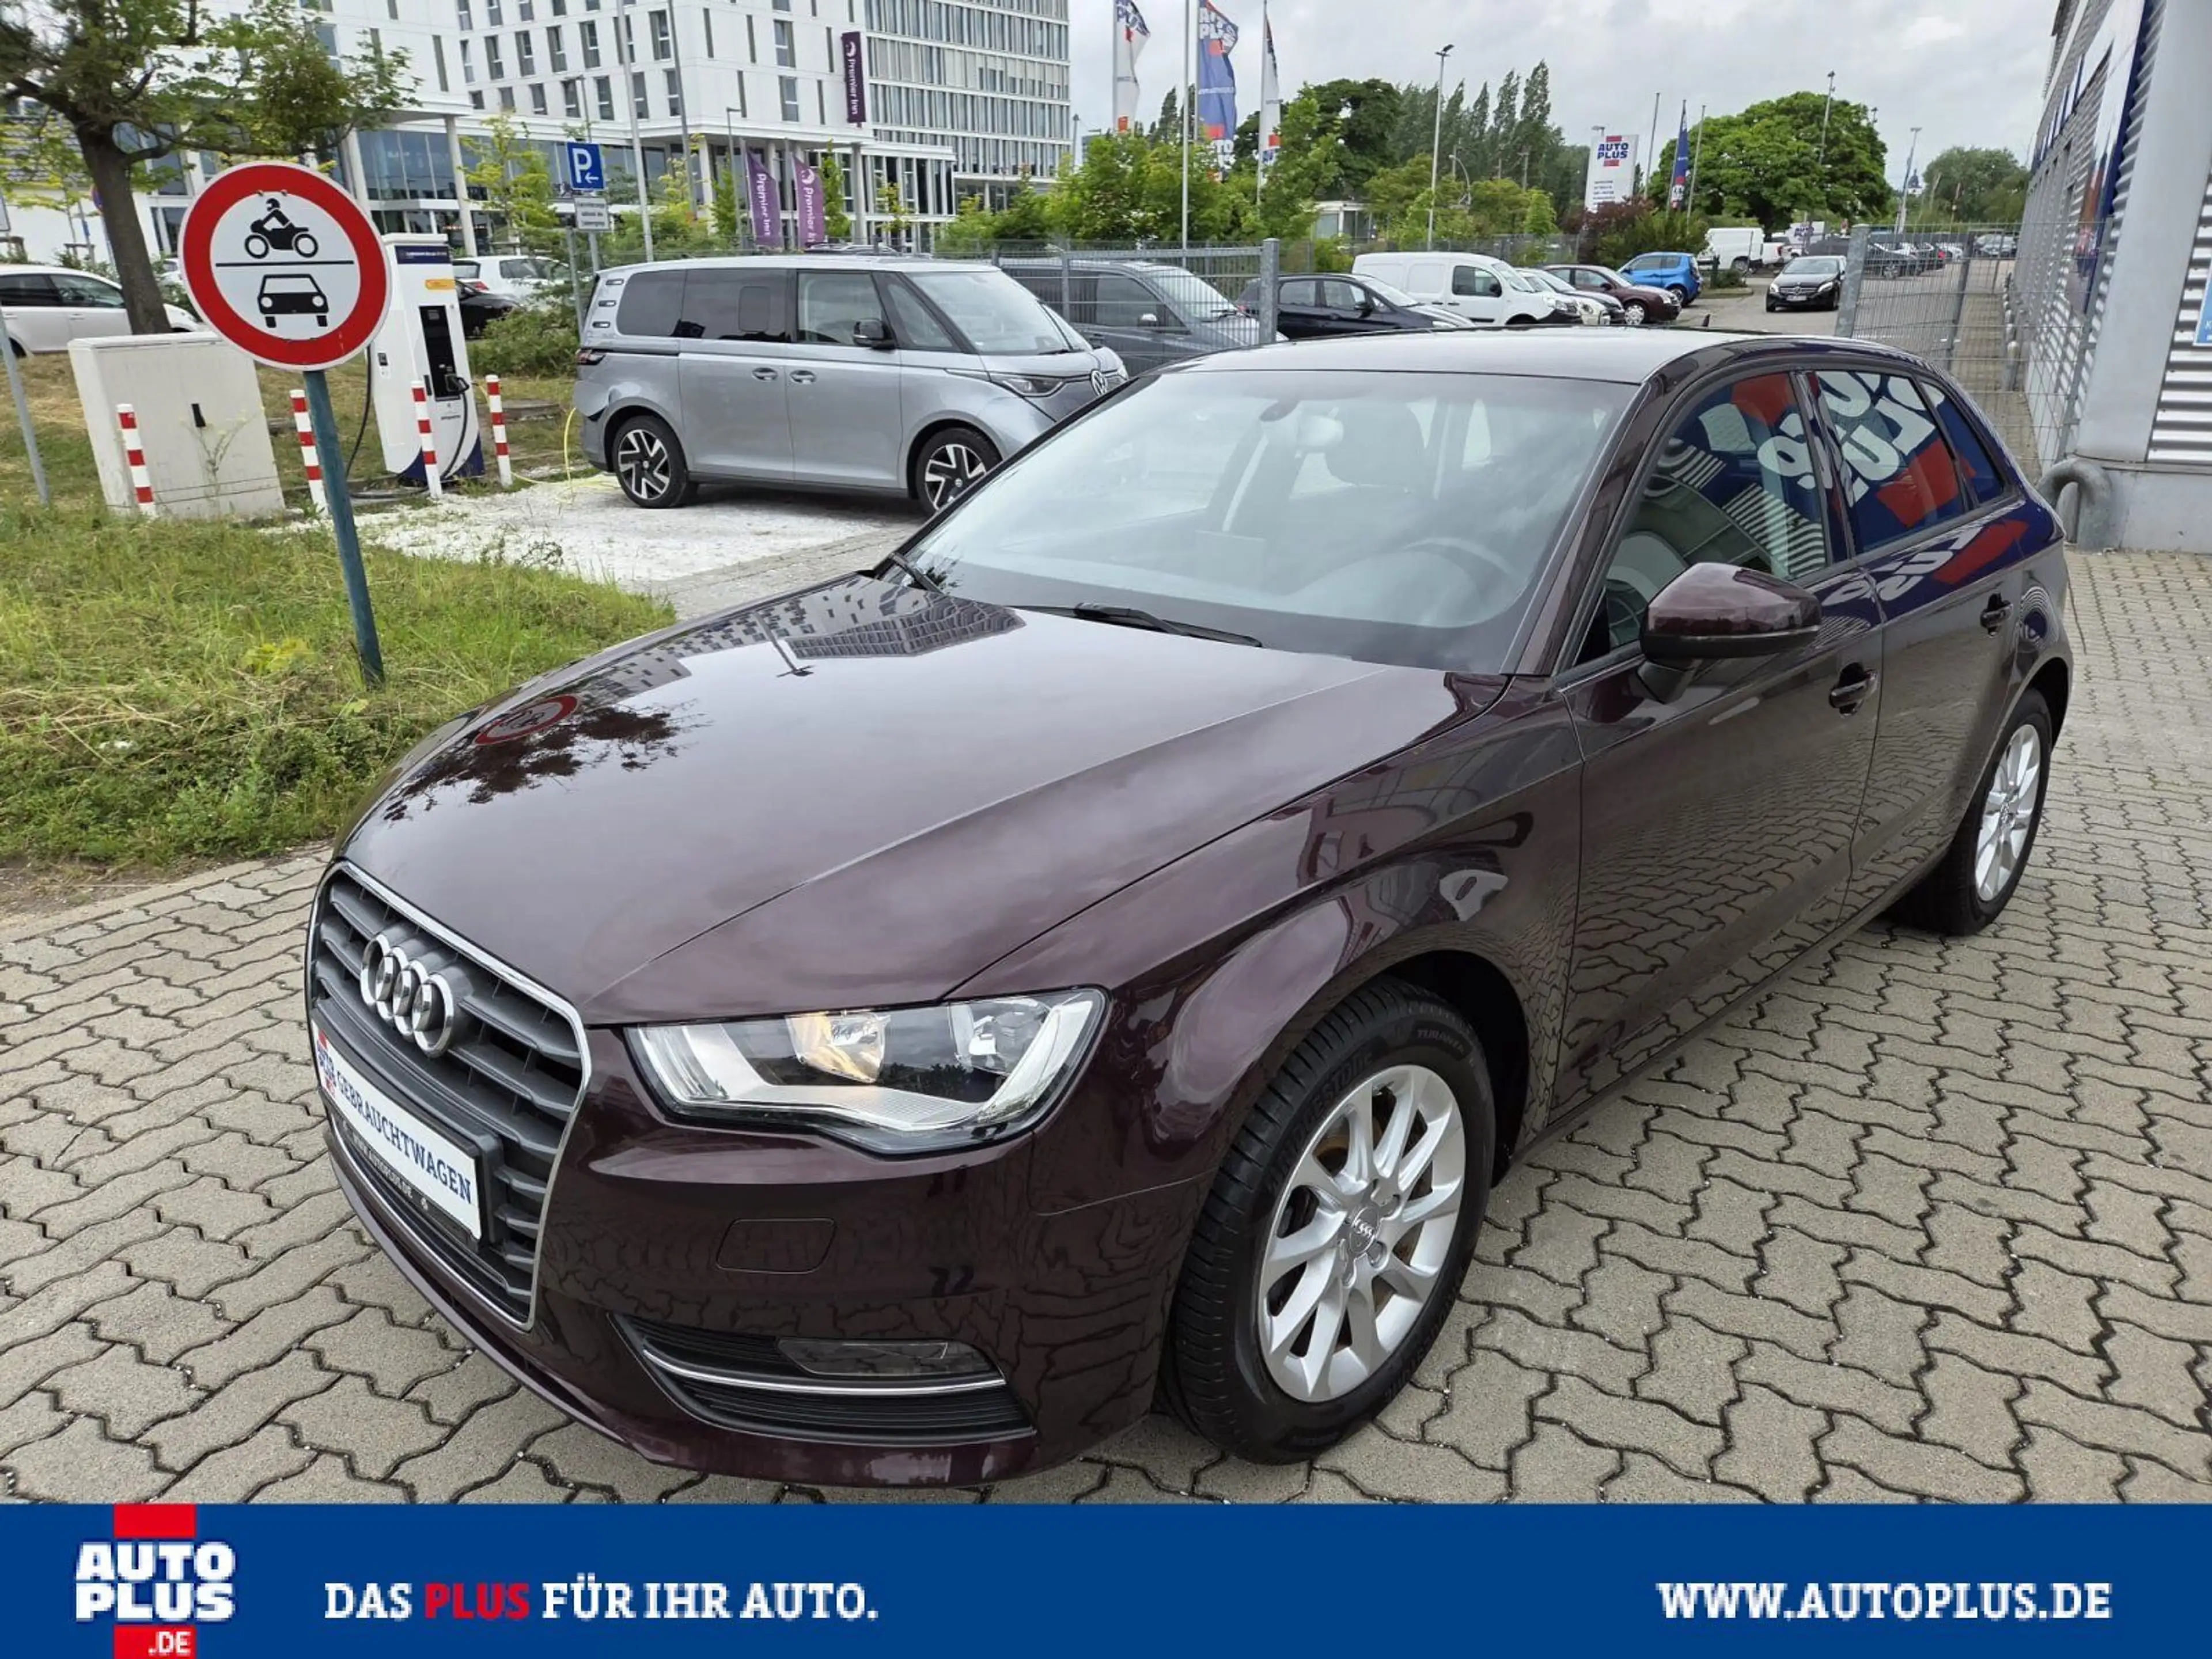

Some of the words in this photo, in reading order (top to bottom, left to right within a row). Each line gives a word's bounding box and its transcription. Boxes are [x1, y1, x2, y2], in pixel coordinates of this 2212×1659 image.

[847, 59, 858, 97] Premier
[572, 147, 592, 184] P
[1597, 151, 1628, 160] PLUS
[1598, 142, 1628, 151] AUTO
[756, 173, 768, 218] Premier
[803, 187, 816, 229] Premier
[336, 1070, 472, 1205] GEBRAUCHTWAGEN
